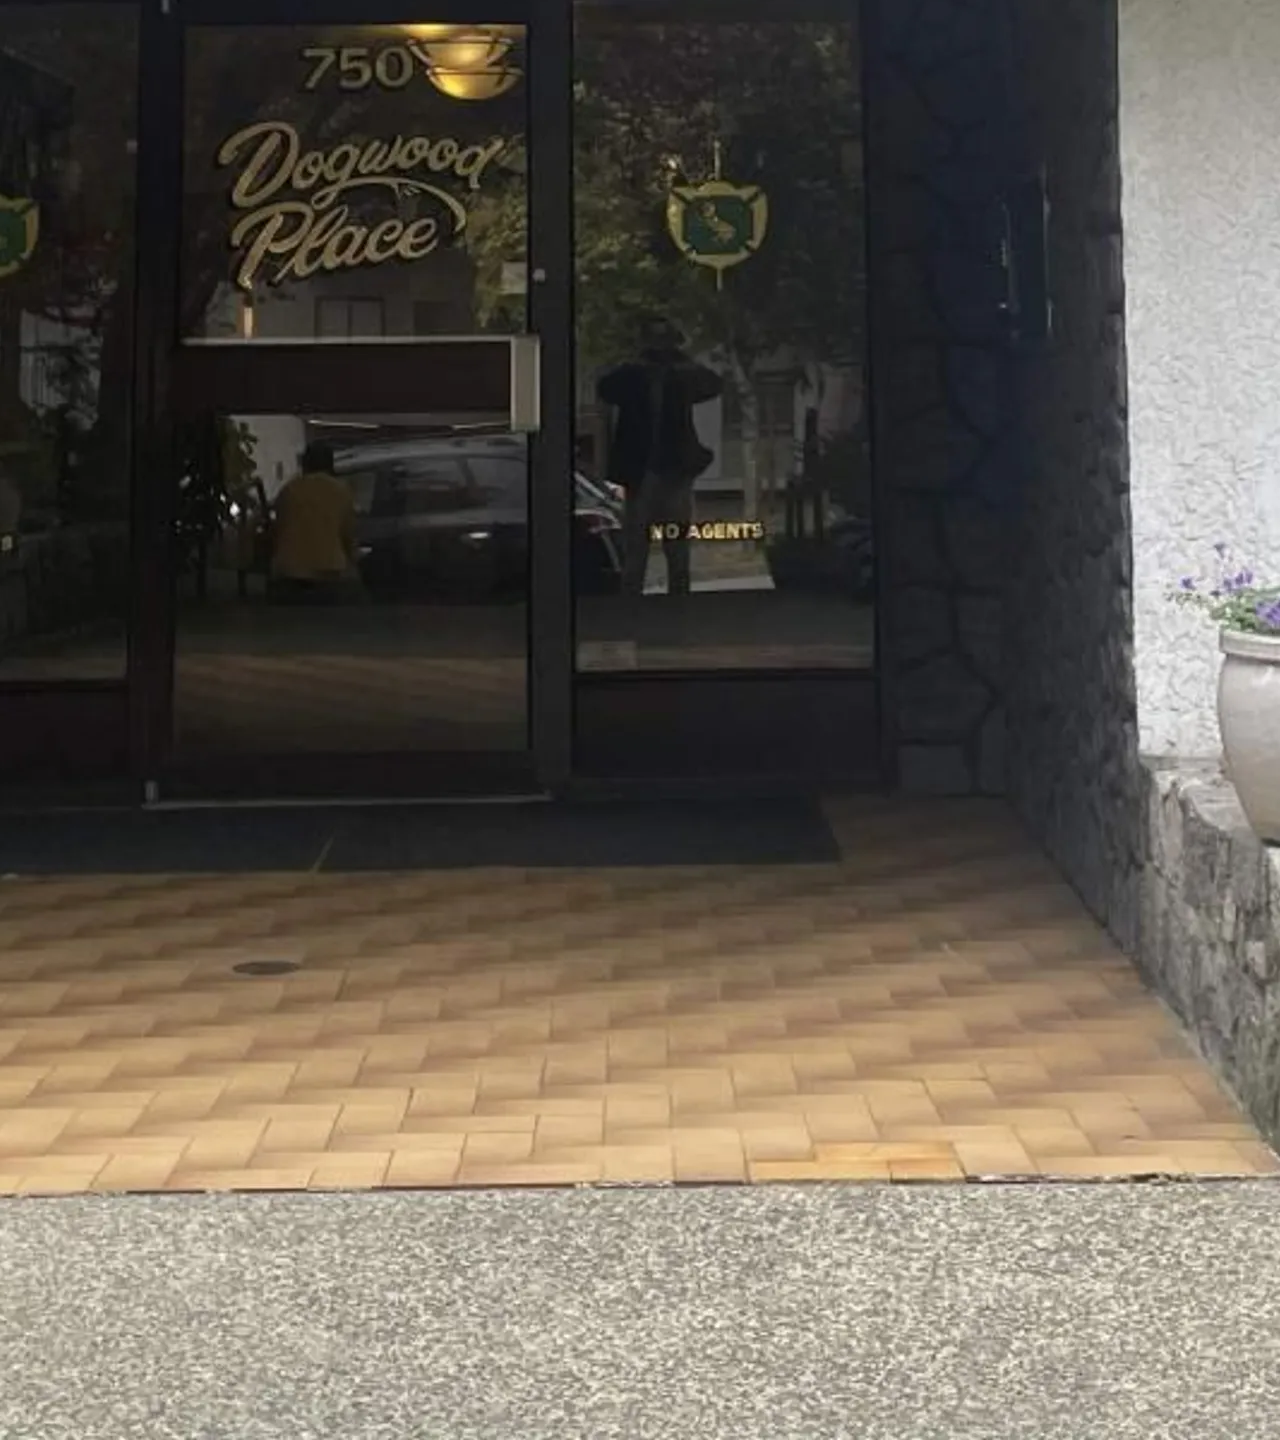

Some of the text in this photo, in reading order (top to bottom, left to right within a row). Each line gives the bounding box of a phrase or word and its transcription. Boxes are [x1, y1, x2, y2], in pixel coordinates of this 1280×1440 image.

[302, 46, 415, 90] 750
[219, 121, 507, 210] Dogwood
[231, 202, 438, 290] Place
[649, 521, 764, 539] NO AGENTS
